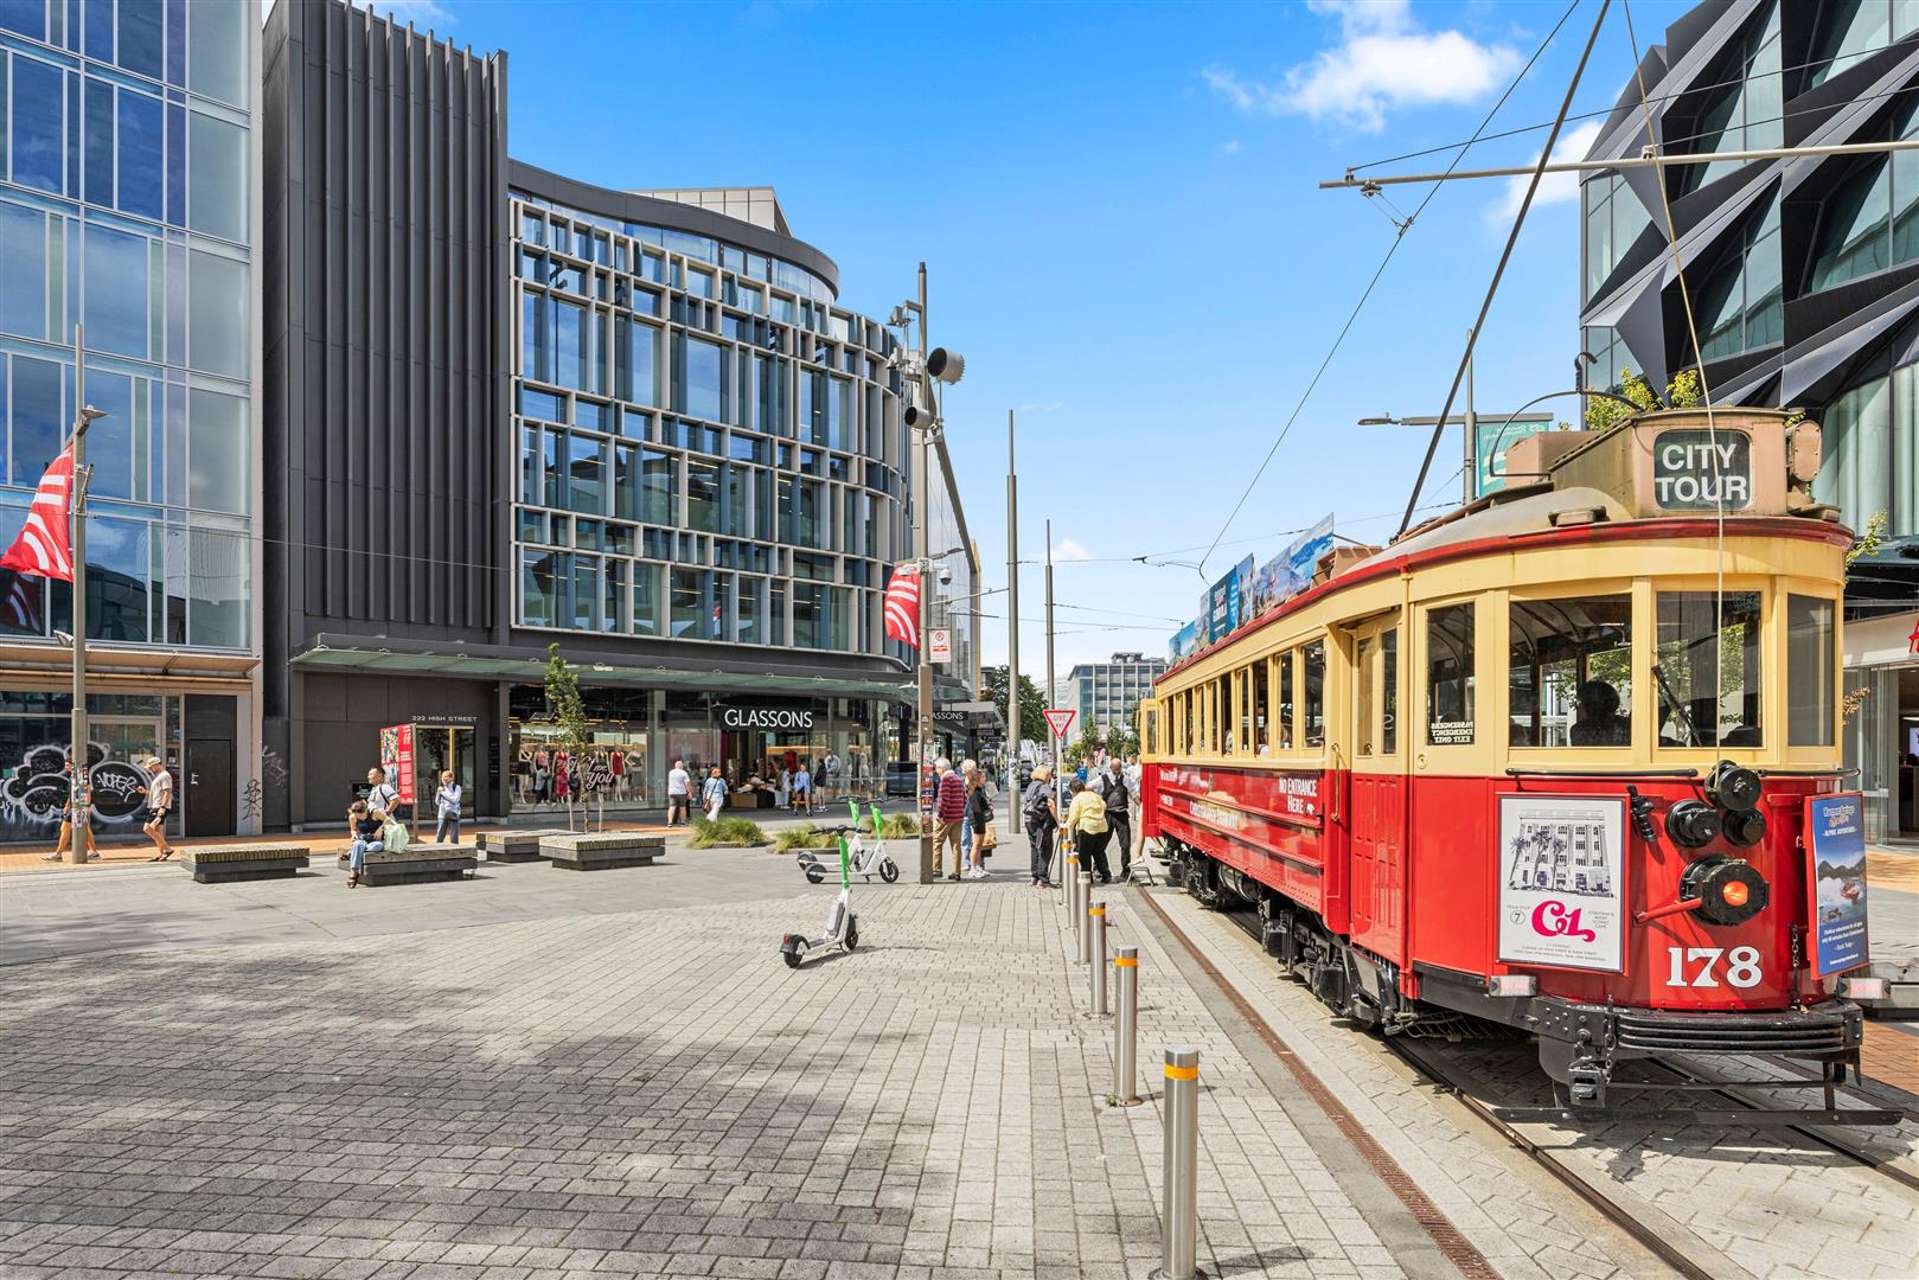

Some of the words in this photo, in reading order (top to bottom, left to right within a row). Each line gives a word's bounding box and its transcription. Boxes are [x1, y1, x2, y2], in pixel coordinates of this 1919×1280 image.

[1662, 444, 1736, 470] CITY
[1655, 475, 1748, 502] TOUR
[724, 709, 813, 728] GLASSONS
[1279, 777, 1288, 794] NO
[1288, 778, 1318, 797] ENTRANCE
[1664, 945, 1763, 988] 178
